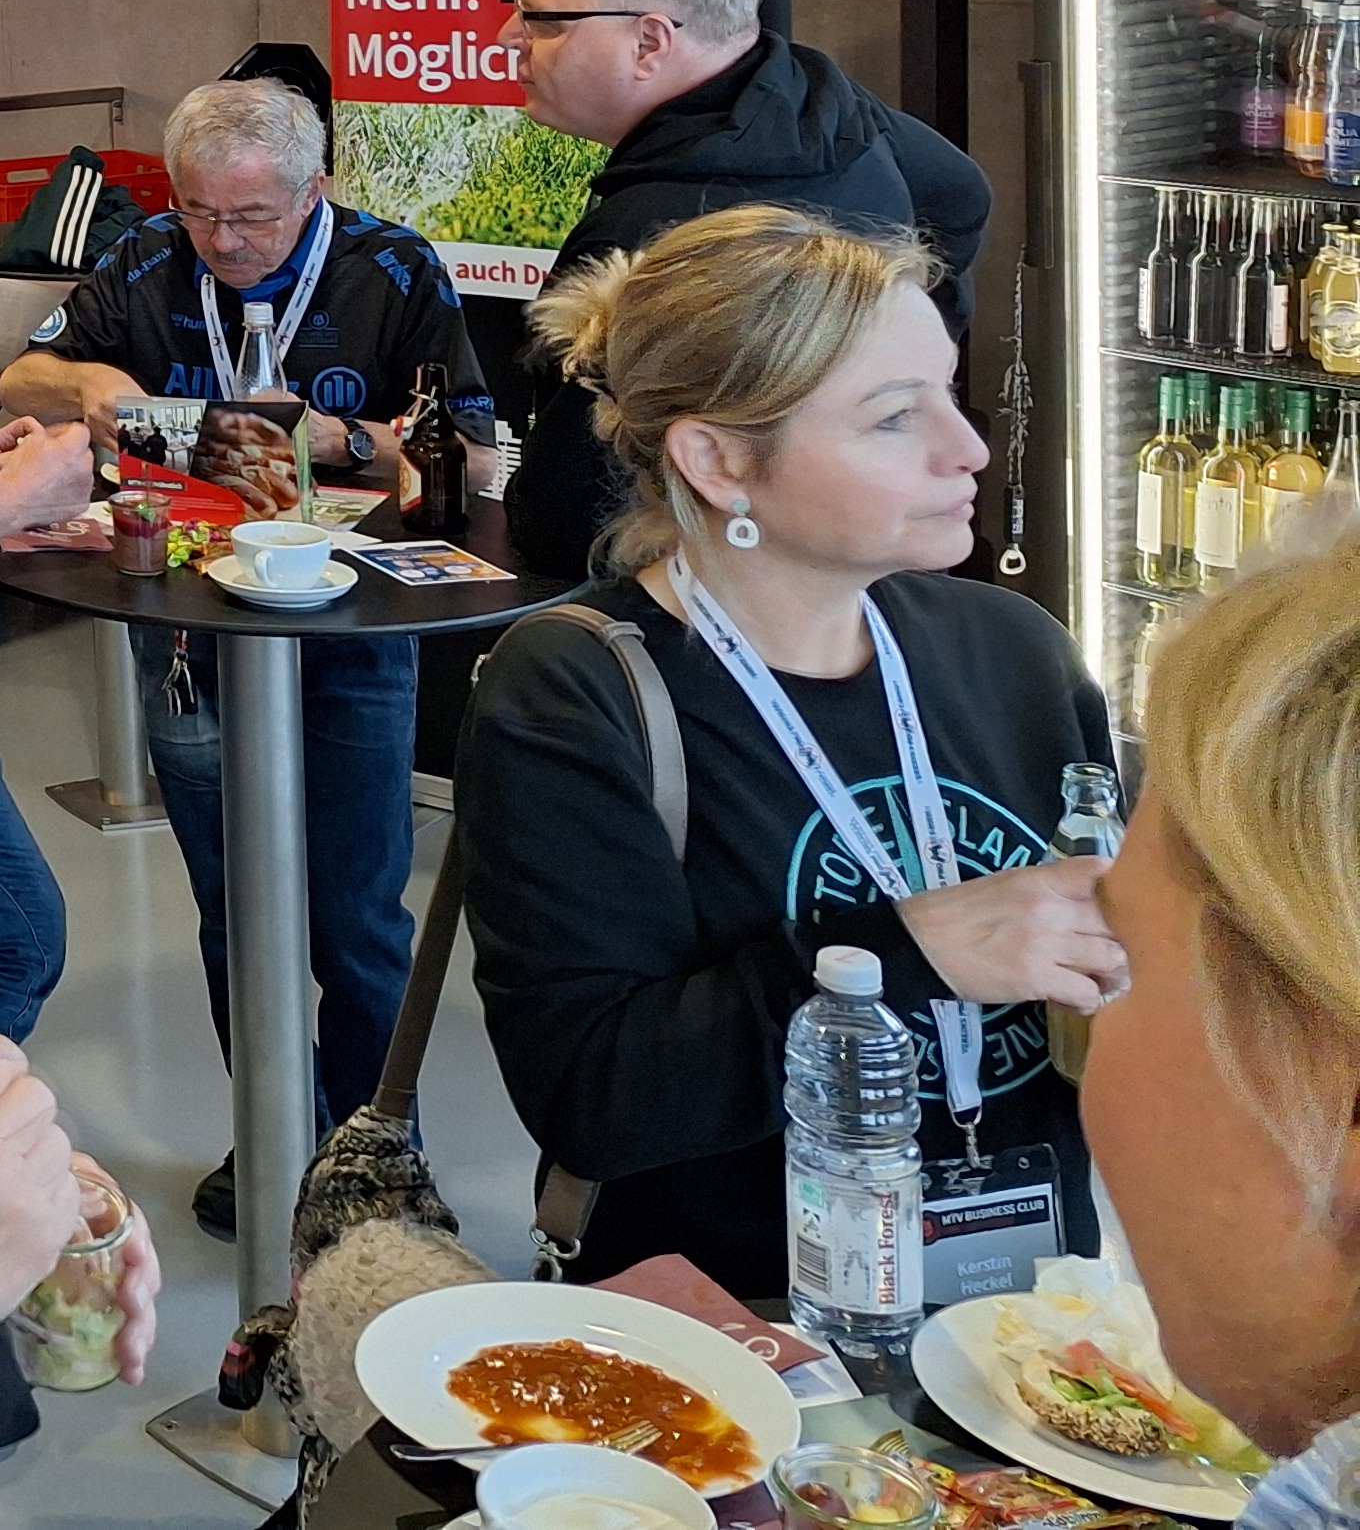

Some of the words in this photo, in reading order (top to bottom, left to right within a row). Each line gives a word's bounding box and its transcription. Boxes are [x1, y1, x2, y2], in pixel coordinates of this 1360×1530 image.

[455, 260, 517, 284] auch
[941, 1212, 964, 1226] MTV
[964, 1203, 1016, 1222] BUSINESS
[1017, 1199, 1045, 1213] CLUB
[957, 1255, 1013, 1277] Kerstin
[878, 1255, 896, 1305] Black
